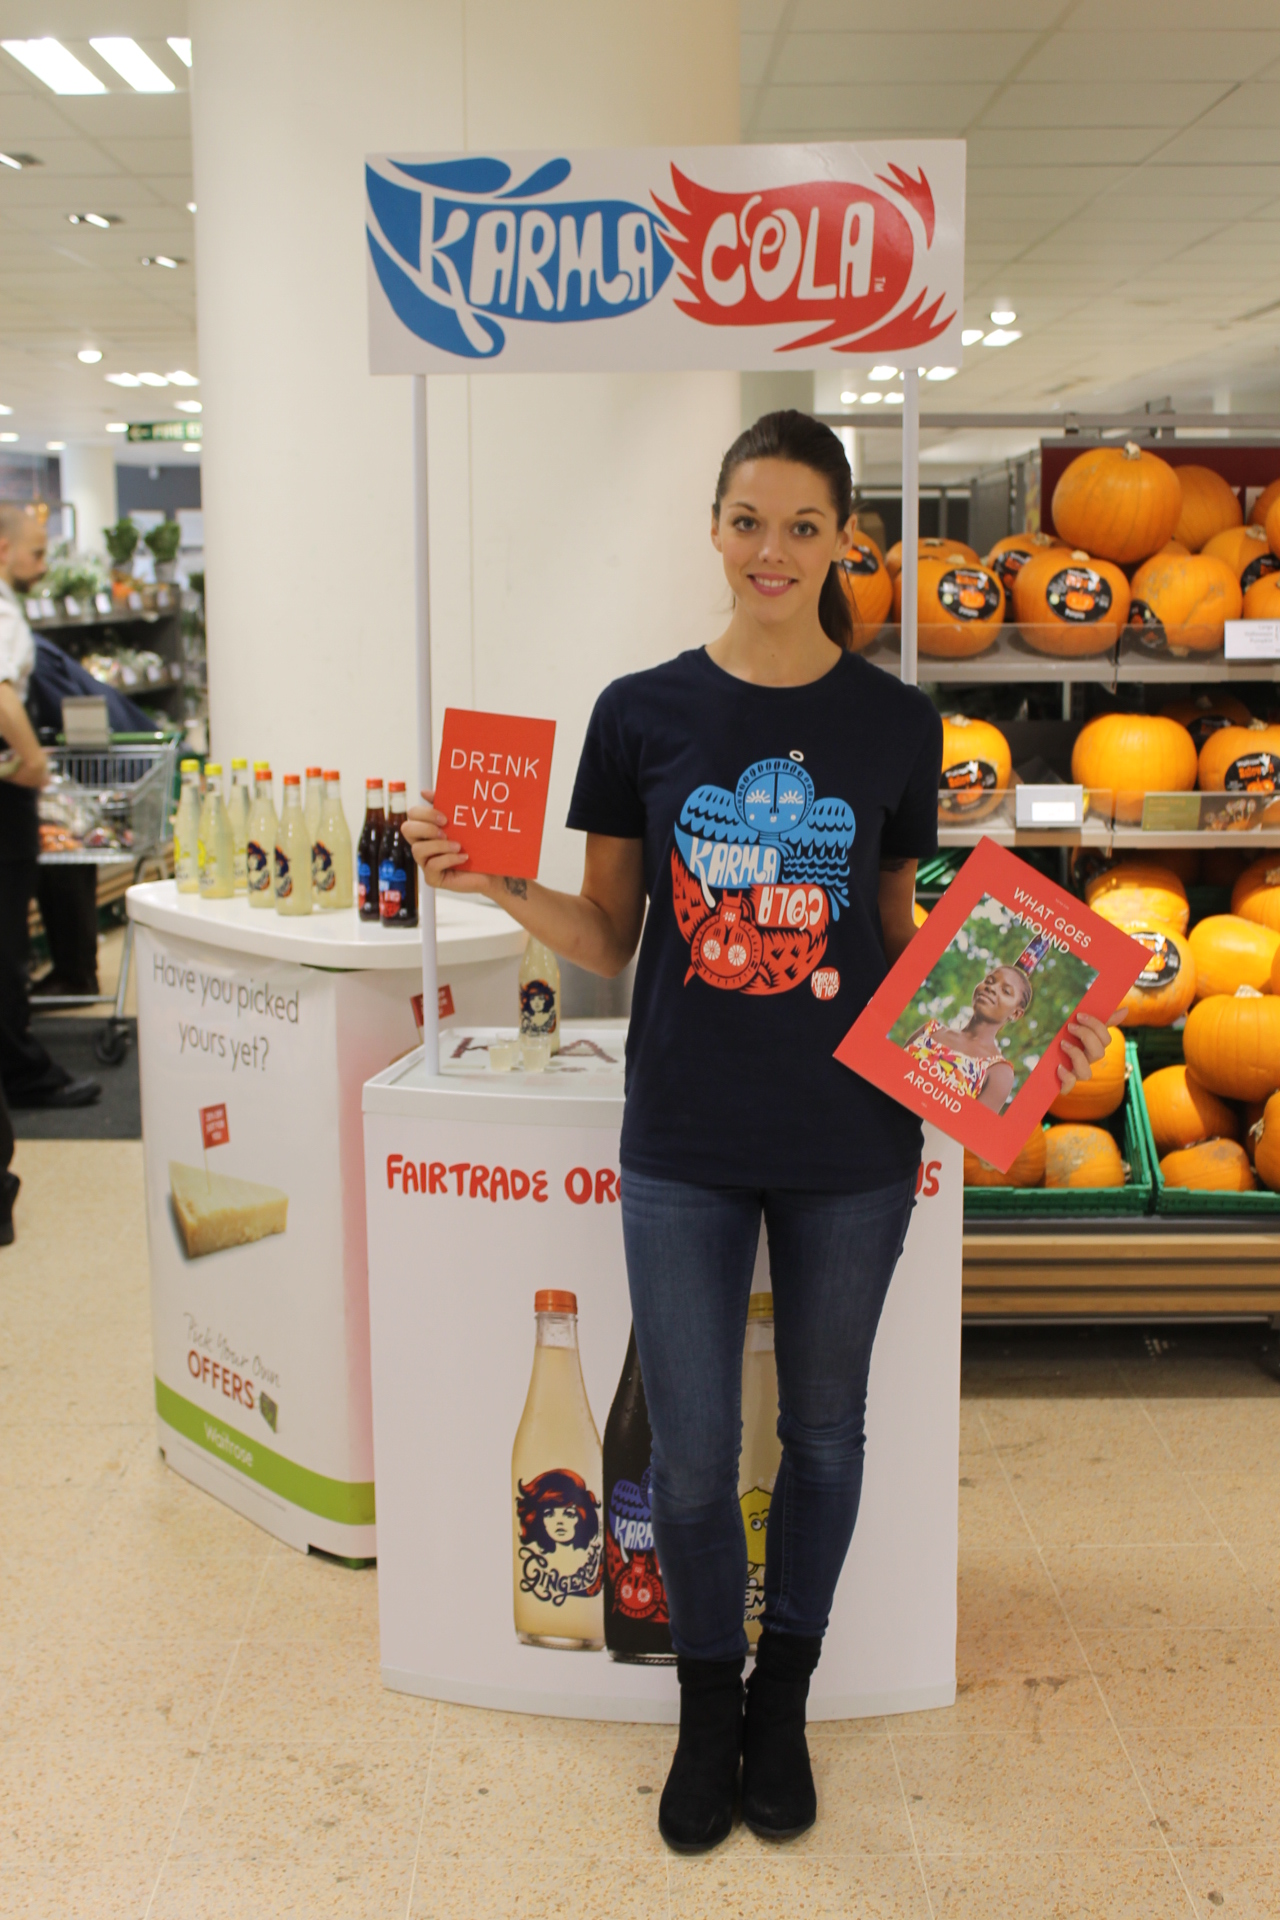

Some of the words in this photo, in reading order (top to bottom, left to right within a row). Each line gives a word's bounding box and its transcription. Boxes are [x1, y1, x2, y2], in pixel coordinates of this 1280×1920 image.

[420, 192, 655, 353] KARMA
[701, 194, 876, 307] COLA
[450, 748, 540, 780] DRINK
[472, 778, 510, 804] NO
[452, 804, 522, 834] EVIL
[690, 836, 777, 908] KARMA
[758, 886, 824, 932] COLA
[1012, 886, 1055, 921] WHAT
[1053, 916, 1092, 948] GOES
[1012, 911, 1071, 955] AROUND
[152, 952, 196, 994] Have
[200, 973, 233, 1007] you
[236, 978, 300, 1024] picked
[178, 1021, 226, 1059] yours
[230, 1034, 270, 1072] yet?
[903, 1068, 962, 1115] AROUND
[918, 1057, 967, 1098] COMES
[386, 1153, 549, 1204] FAIRTRADE
[186, 1348, 255, 1410] OFFERS
[203, 1420, 254, 1468] Waitrose
